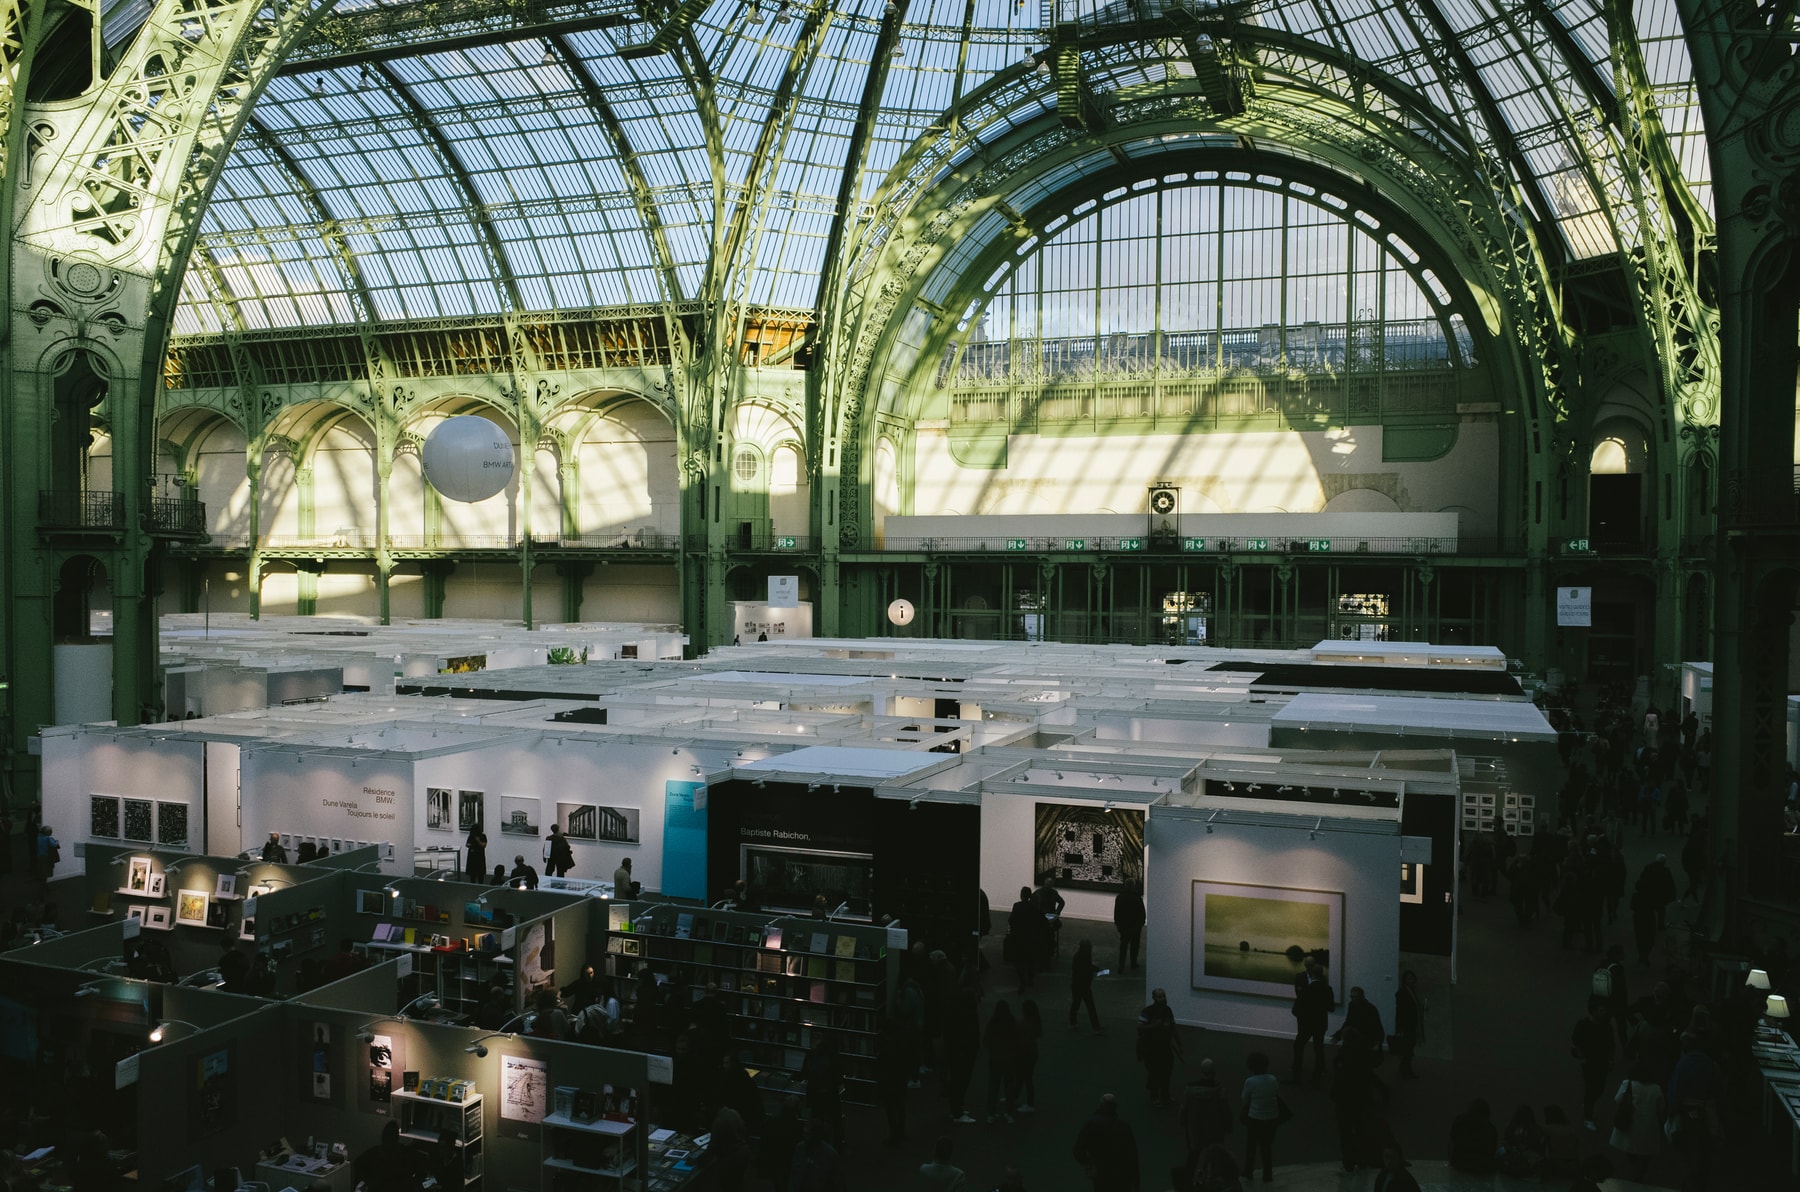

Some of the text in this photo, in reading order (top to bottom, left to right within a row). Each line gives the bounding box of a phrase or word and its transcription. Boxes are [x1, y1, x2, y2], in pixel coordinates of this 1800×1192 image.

[482, 461, 501, 469] BMW
[363, 787, 395, 796] Résidence
[322, 799, 358, 809] Dune Varela
[347, 808, 396, 820] Toujours le soleil
[740, 827, 772, 838] Baptiste
